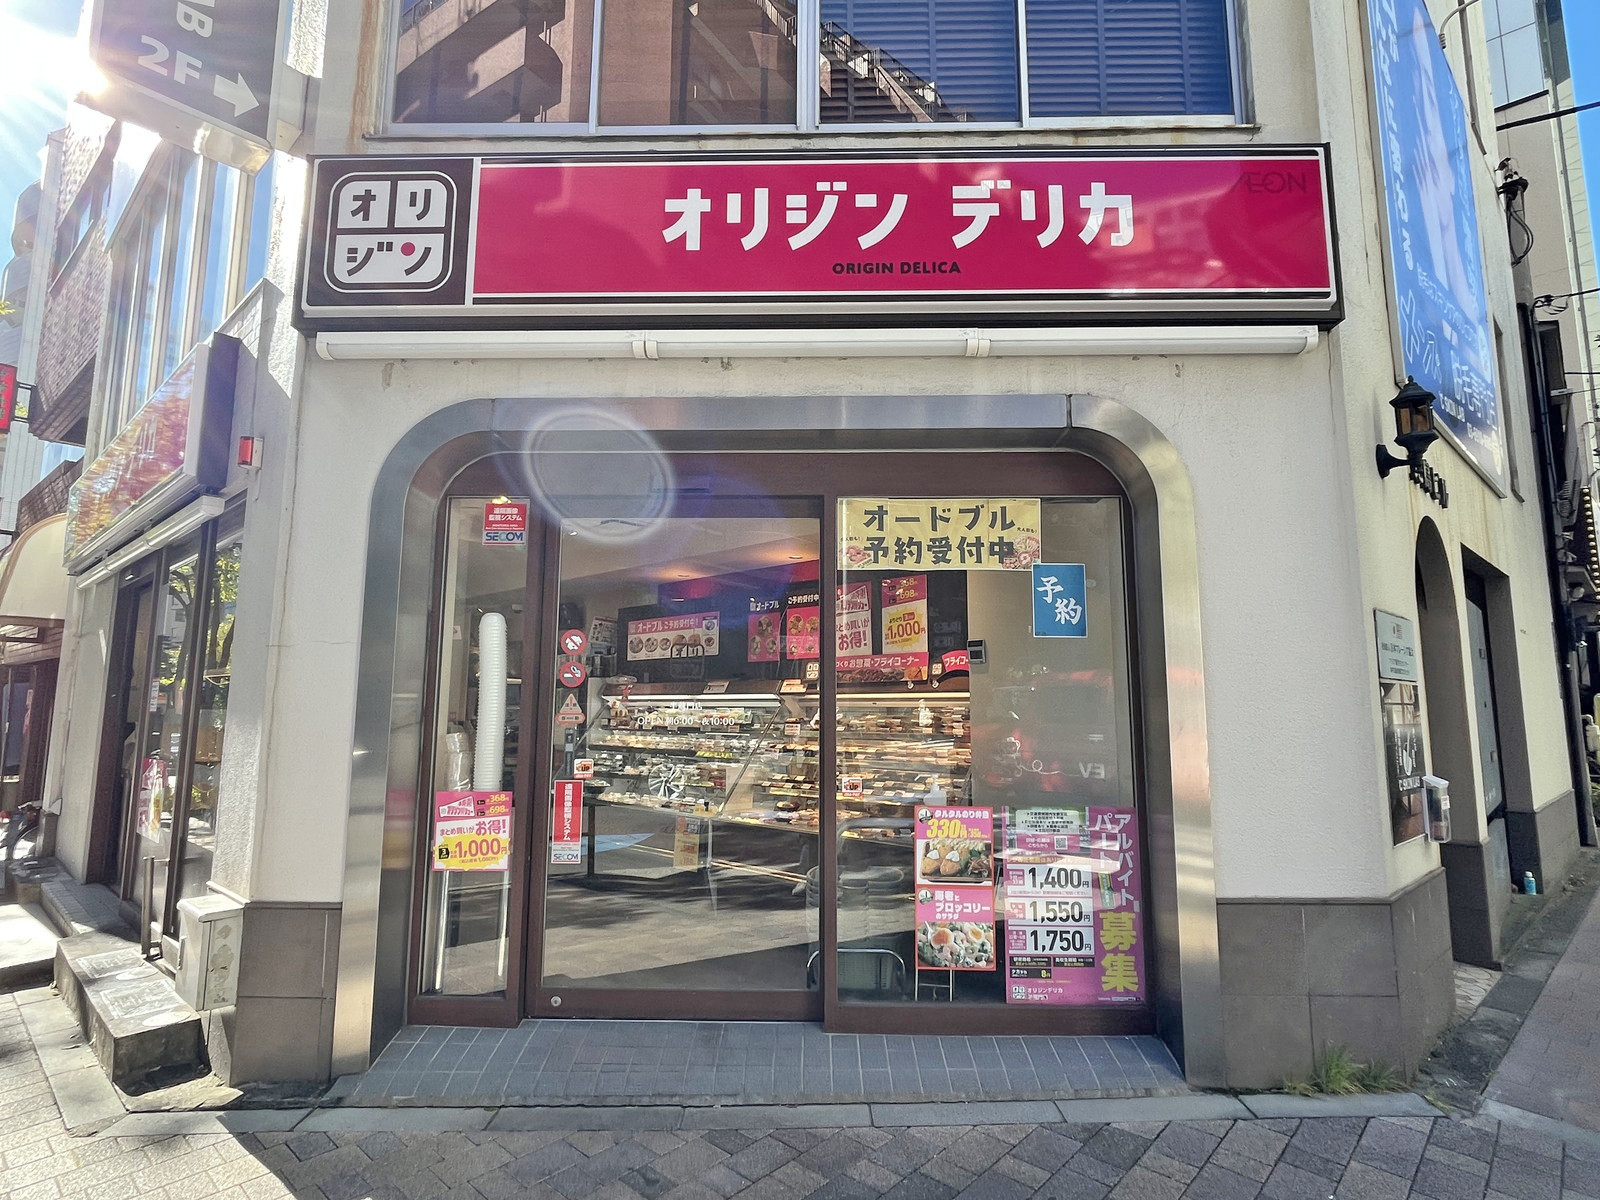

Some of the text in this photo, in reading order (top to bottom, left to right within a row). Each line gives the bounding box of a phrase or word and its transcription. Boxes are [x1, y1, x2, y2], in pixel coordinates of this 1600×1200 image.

[138, 34, 203, 85] 2F
[662, 179, 1135, 252] オリジン デリカ
[832, 262, 961, 275] ORIGIN DELICA
[863, 504, 1016, 532] オードブル
[485, 532, 524, 542] SECOM
[863, 535, 1015, 565] 予約受付中
[1036, 576, 1083, 626] 予約
[637, 717, 665, 726] OPEN
[454, 837, 508, 859] 1,000円
[1094, 812, 1114, 869] パート
[553, 853, 579, 862] SECOM
[1112, 813, 1135, 907] アルバイト
[1028, 867, 1090, 889] 1,400円
[934, 901, 991, 914] ブロッコリー
[1029, 901, 1091, 924] 1,550円
[1030, 930, 1092, 953] 1,750円
[1099, 911, 1140, 993] 募集
